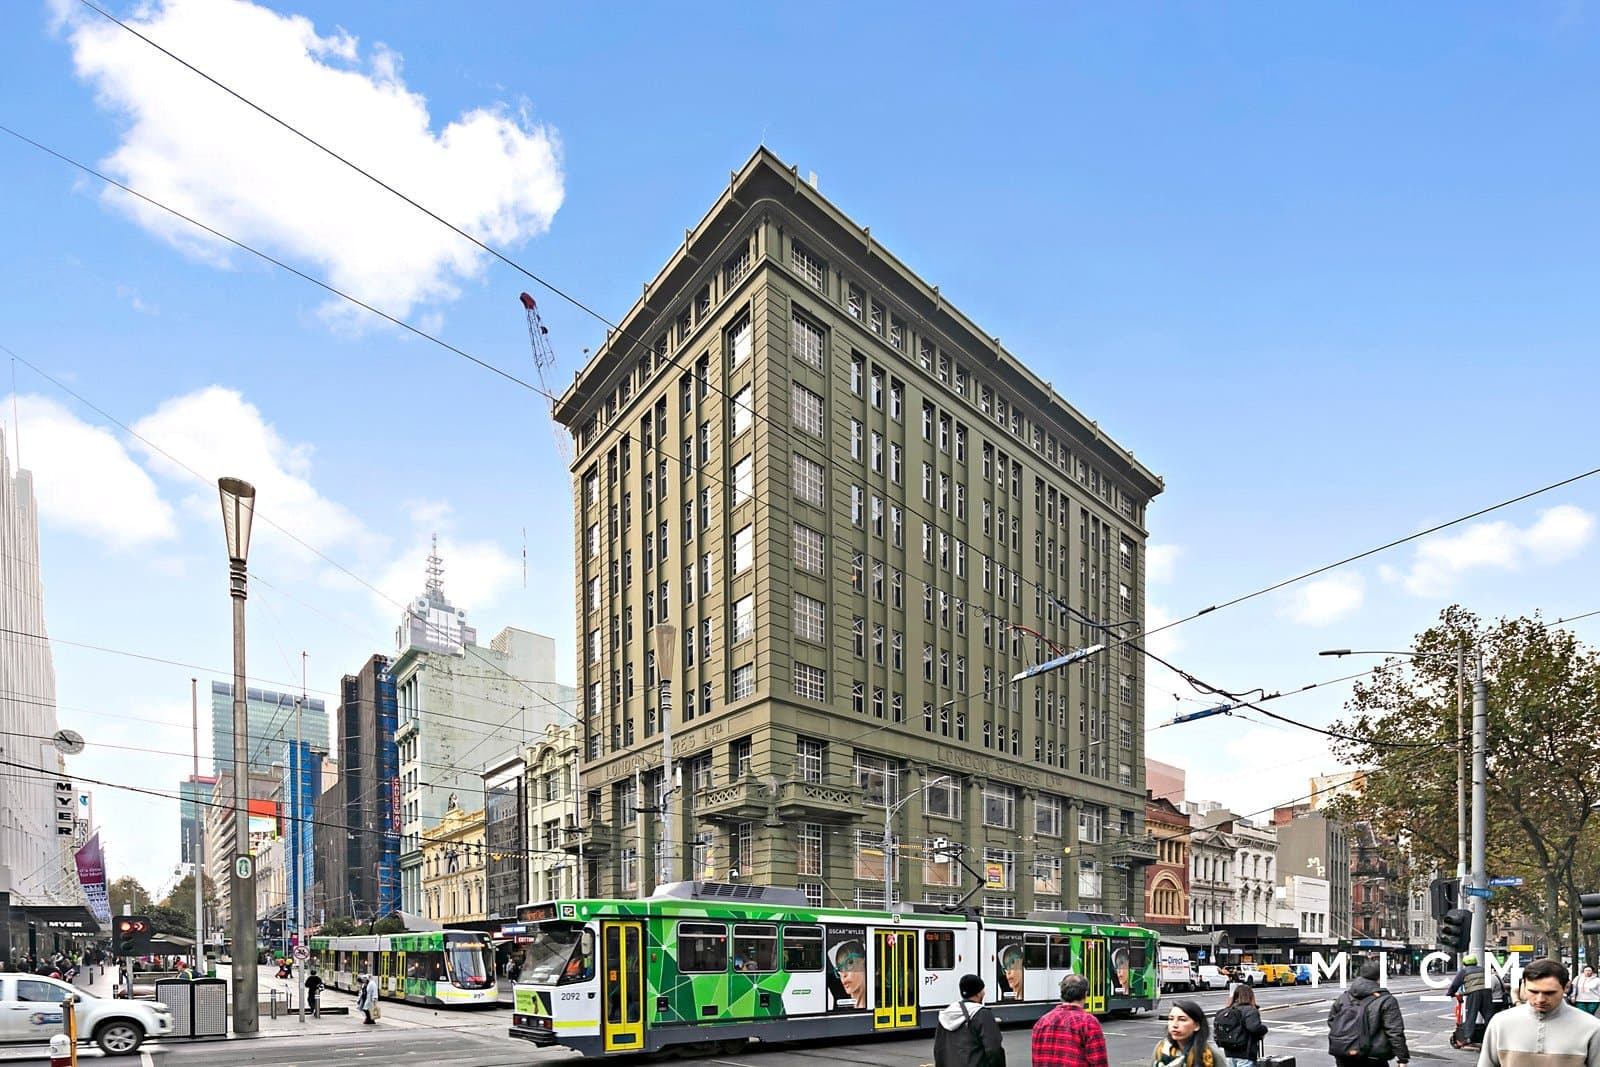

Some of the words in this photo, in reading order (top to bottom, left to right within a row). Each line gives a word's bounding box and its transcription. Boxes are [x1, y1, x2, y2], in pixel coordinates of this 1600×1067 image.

[606, 751, 645, 779] LONDON
[649, 735, 696, 763] STRES
[938, 746, 989, 773] LONDON
[996, 762, 1039, 784] STORES
[56, 782, 72, 836] MYER
[1168, 955, 1183, 965] Direct
